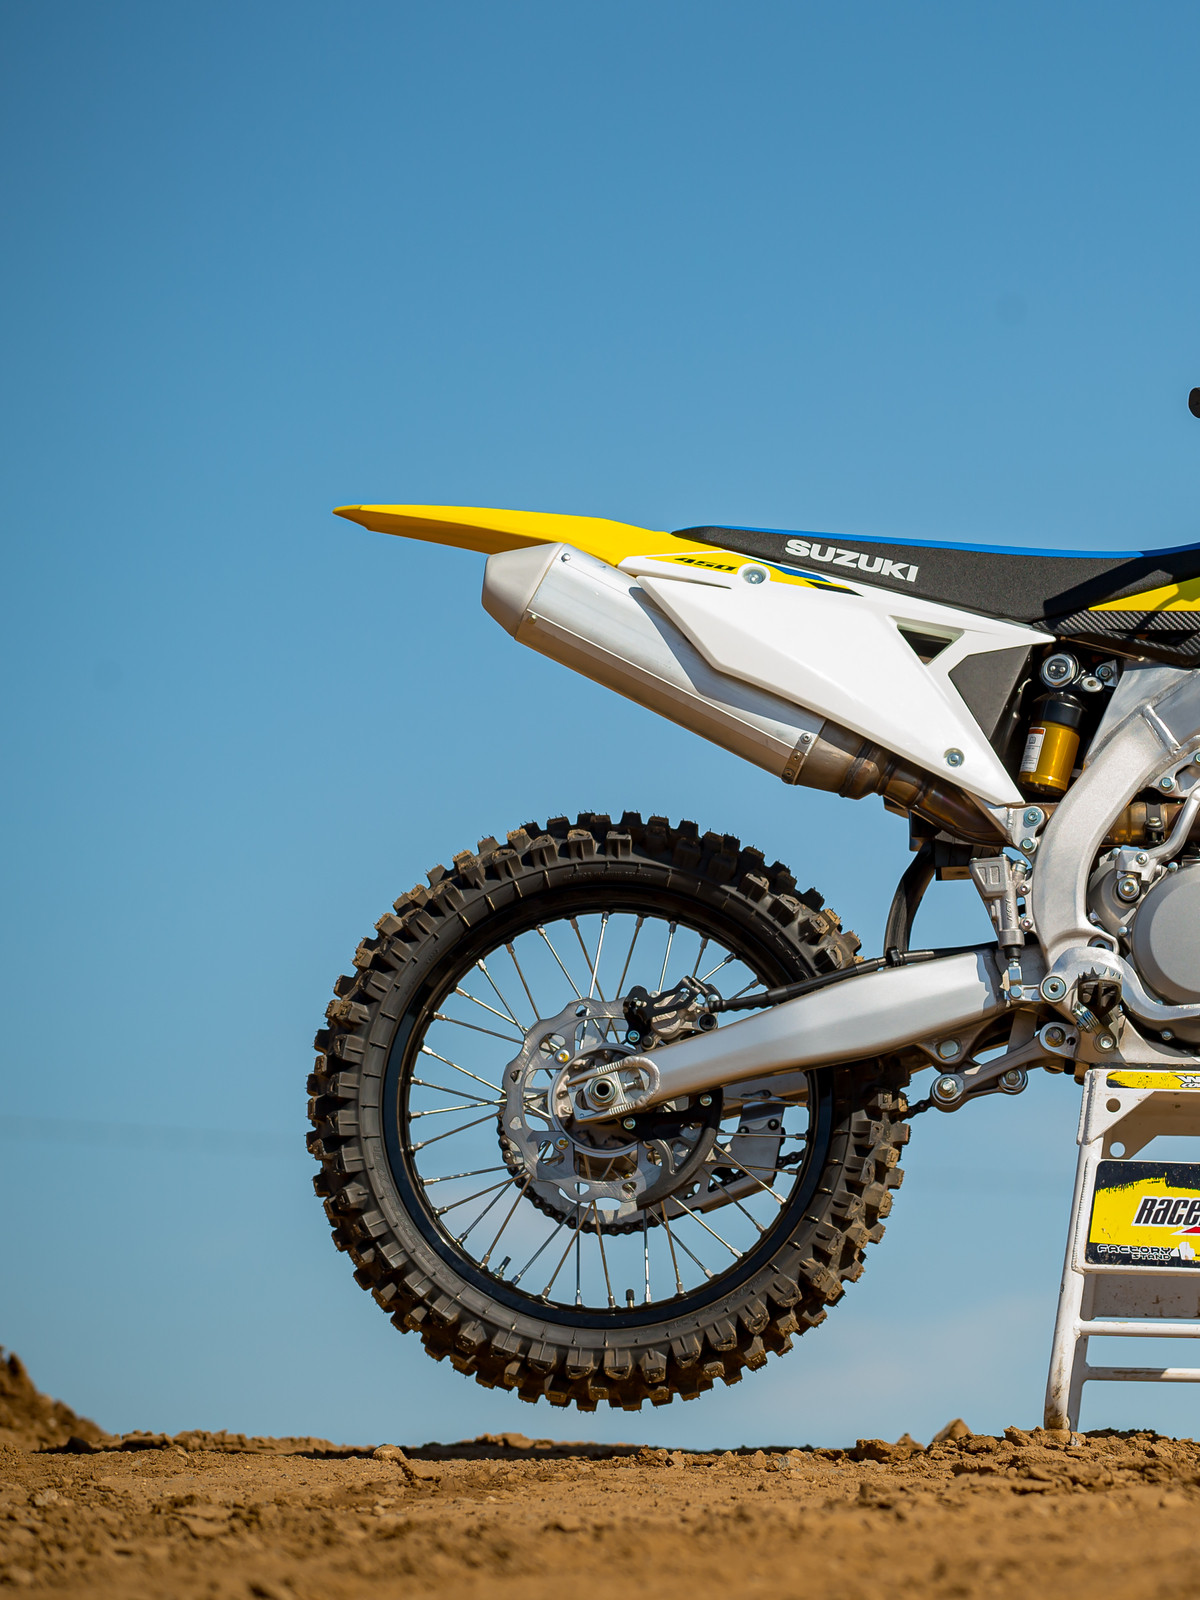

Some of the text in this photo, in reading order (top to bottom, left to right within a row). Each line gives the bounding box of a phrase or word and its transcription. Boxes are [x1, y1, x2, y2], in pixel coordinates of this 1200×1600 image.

[674, 557, 738, 571] 450
[785, 539, 919, 582] SUZUKI
[1097, 1244, 1171, 1255] FACTORY
[1132, 1253, 1172, 1261] STAND
